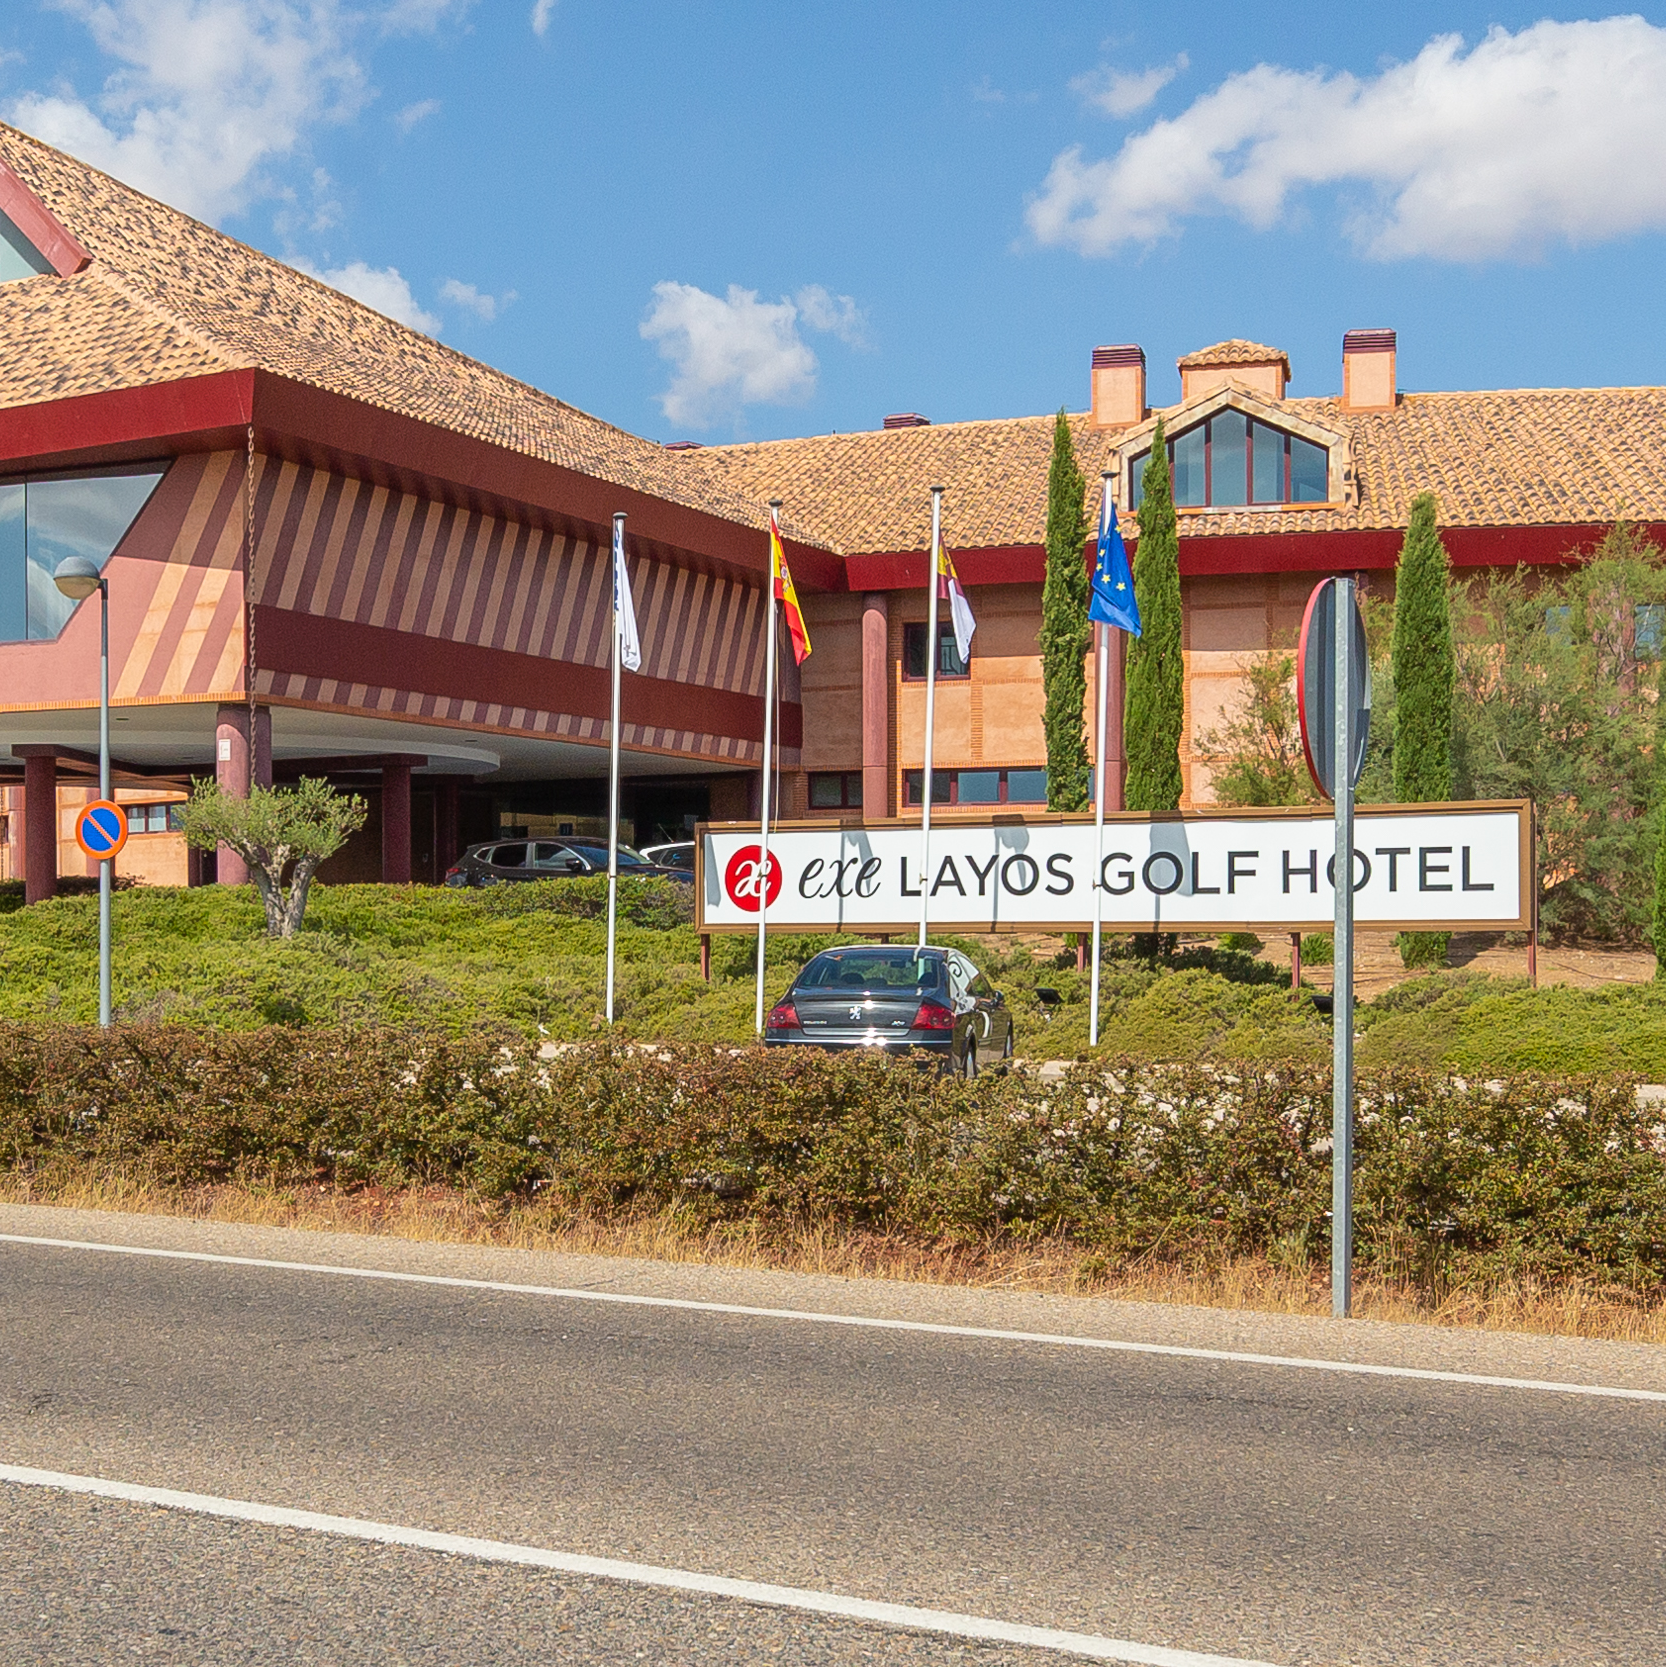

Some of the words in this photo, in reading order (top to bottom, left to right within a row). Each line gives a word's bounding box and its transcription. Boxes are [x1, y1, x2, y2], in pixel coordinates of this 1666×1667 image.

[799, 857, 882, 898] exe
[900, 853, 1074, 896] LAYOS
[1101, 851, 1259, 895] GOLF
[1282, 846, 1494, 894] HOTEL
